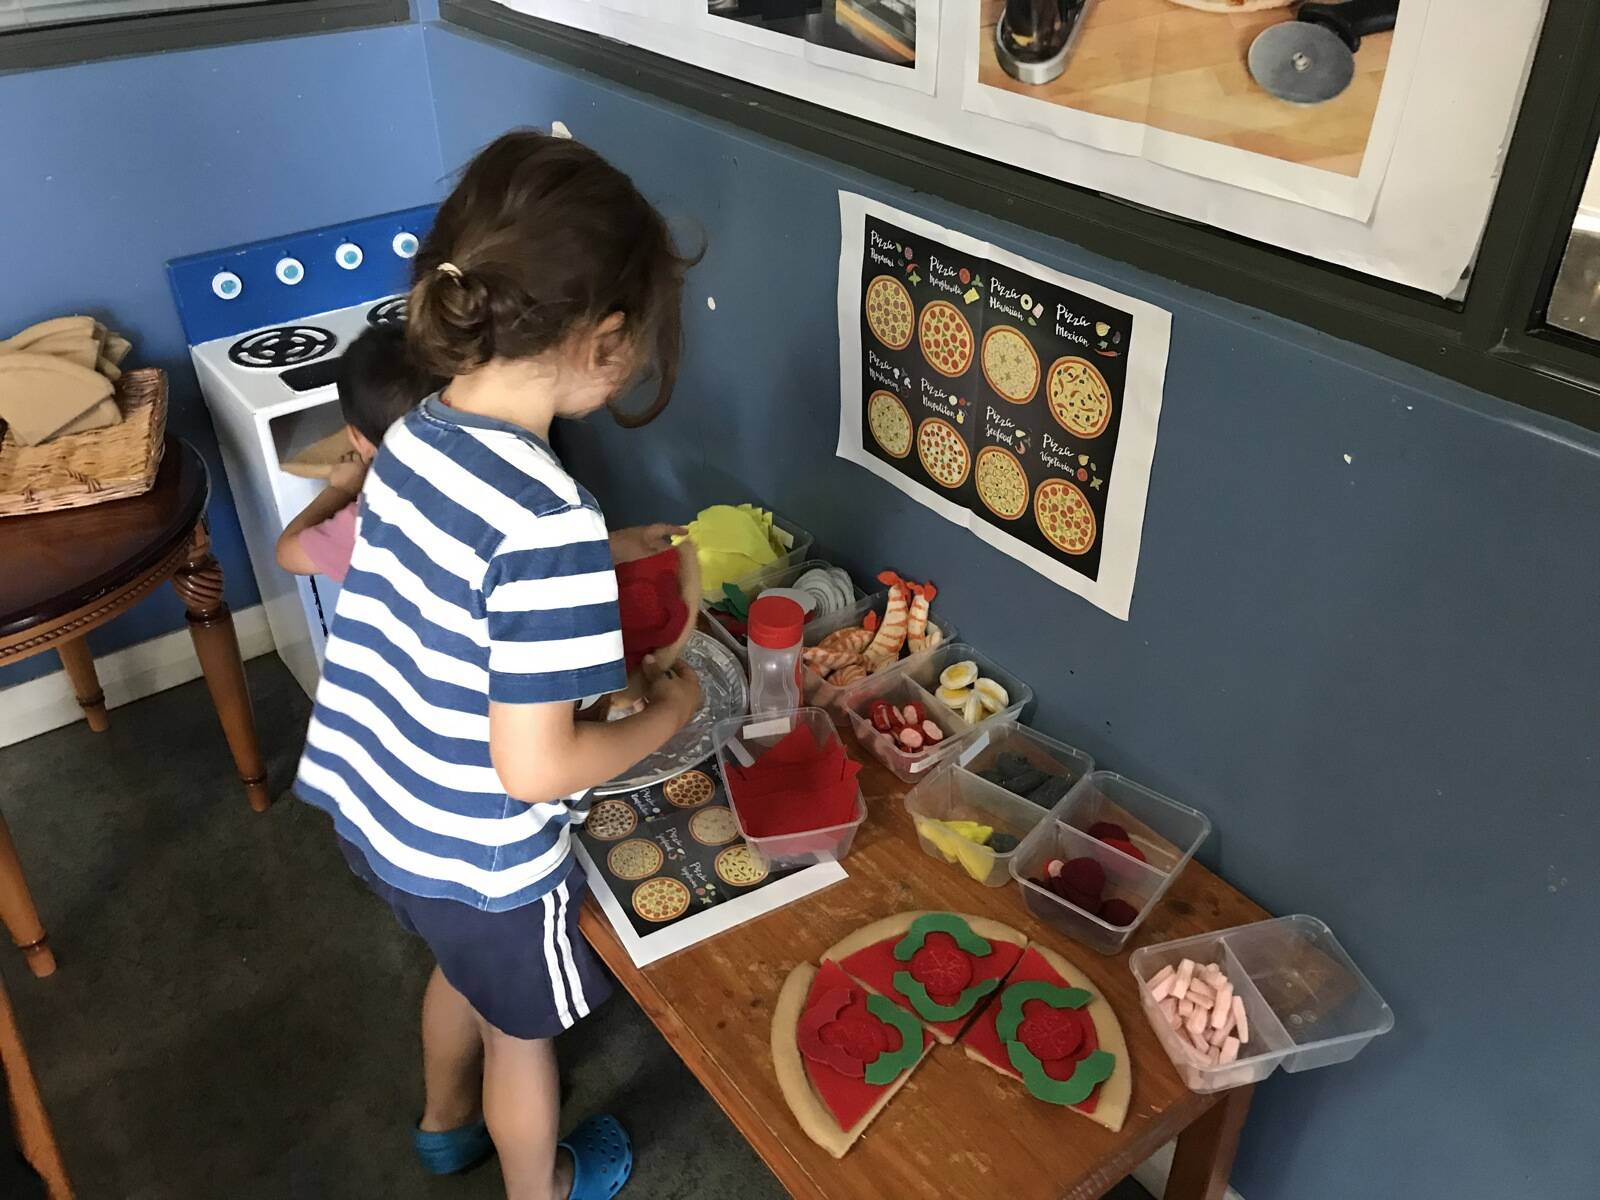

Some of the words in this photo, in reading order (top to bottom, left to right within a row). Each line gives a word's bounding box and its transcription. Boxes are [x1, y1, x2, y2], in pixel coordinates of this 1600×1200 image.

[870, 229, 896, 250] Pizza
[929, 255, 958, 277] Pizza
[989, 276, 1021, 299] Pizza
[989, 296, 1025, 322] Hawaiian
[1056, 303, 1091, 327] Pizza
[1055, 323, 1090, 348] Mexican
[869, 349, 892, 370] Pizza
[920, 377, 948, 399] Pizza
[986, 405, 1015, 429] Pizza
[985, 423, 1014, 447] Seafood
[1042, 433, 1075, 457] Pizza
[1040, 450, 1075, 477] Vegetarian
